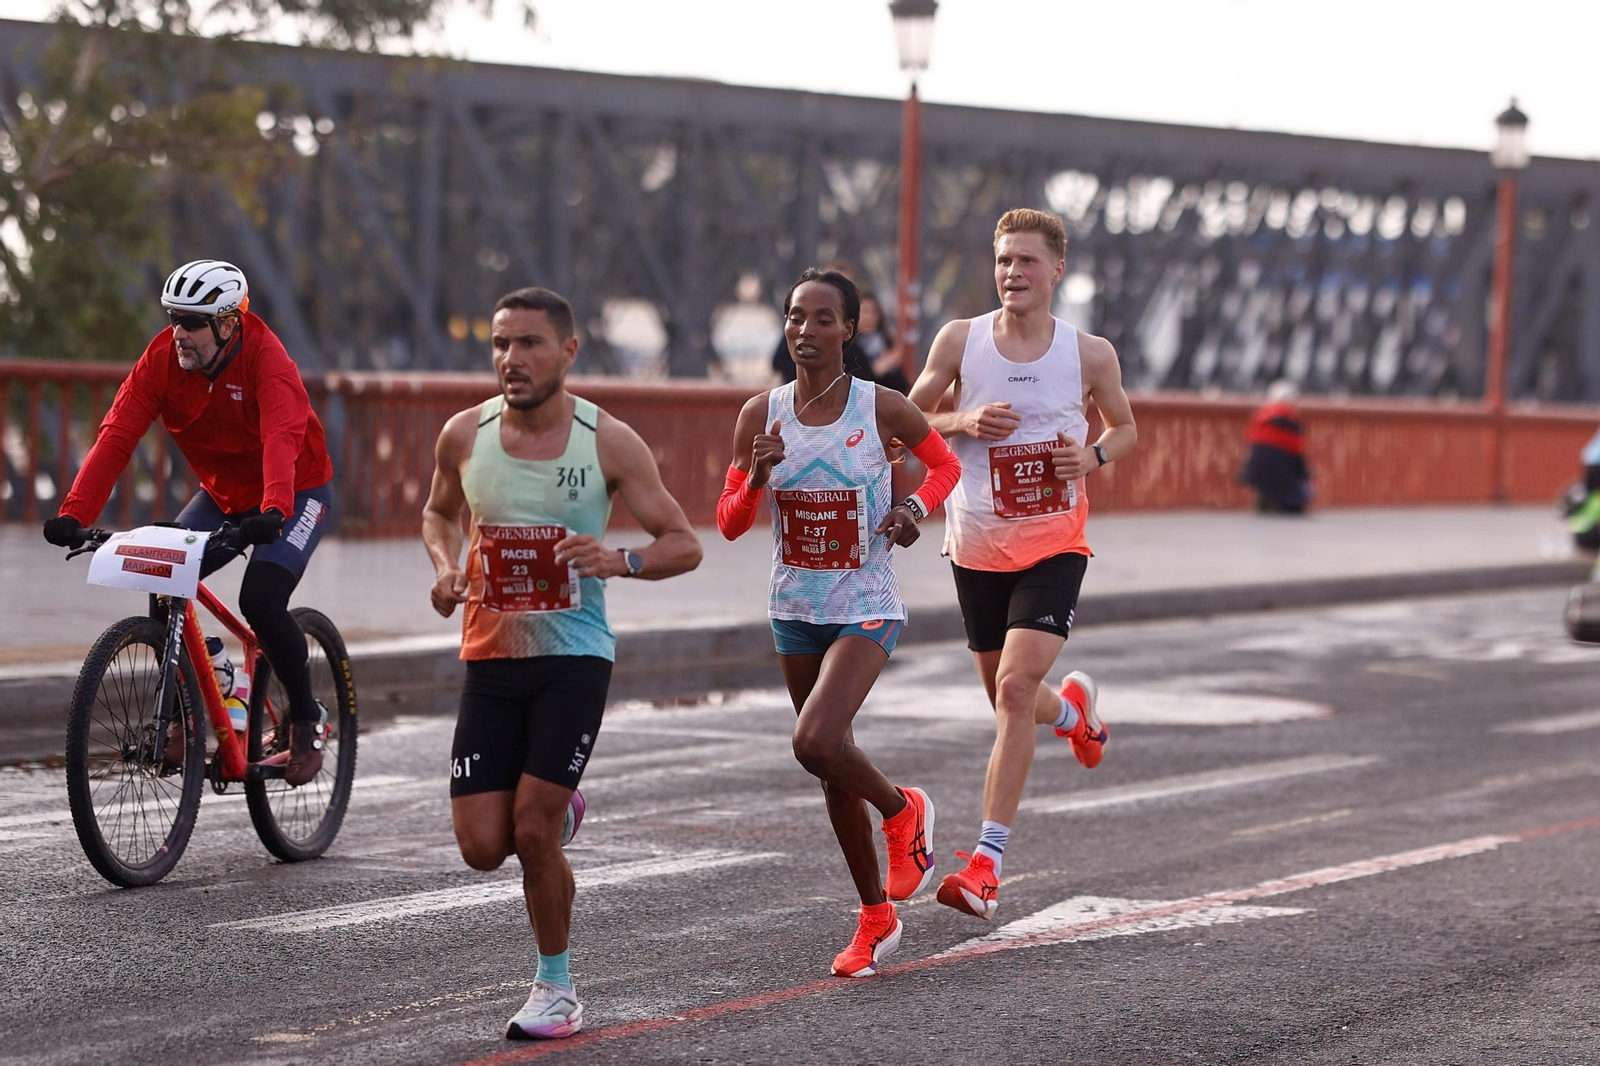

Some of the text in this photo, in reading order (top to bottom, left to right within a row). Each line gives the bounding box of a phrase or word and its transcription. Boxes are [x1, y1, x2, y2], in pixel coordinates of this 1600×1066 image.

[217, 301, 237, 314] POC
[1013, 460, 1045, 477] 273
[795, 491, 850, 503] GENERALI
[795, 509, 838, 521] MISGANE
[496, 527, 559, 540] GENERALI
[804, 526, 827, 537] F-37
[128, 548, 186, 562] CLASIFICADA
[501, 549, 537, 560] PACER
[122, 561, 172, 576] MARATÓN
[512, 565, 529, 576] 23
[341, 660, 355, 715] MAXXIS
[450, 753, 481, 779] 61°
